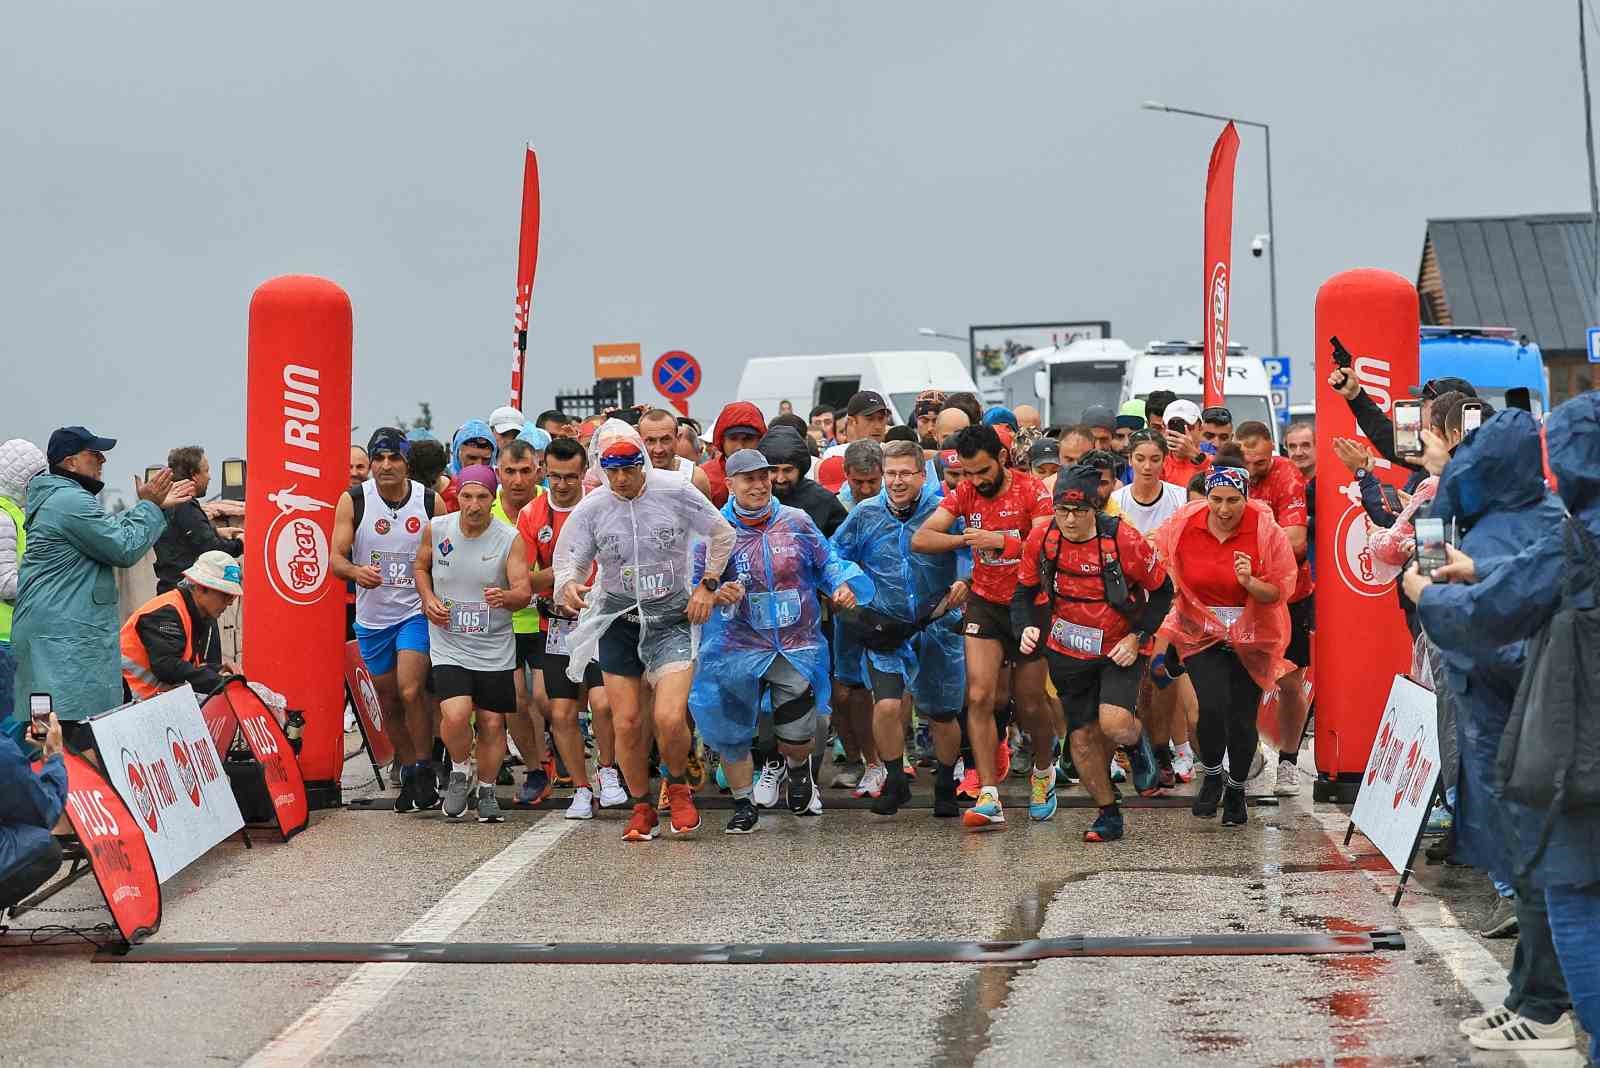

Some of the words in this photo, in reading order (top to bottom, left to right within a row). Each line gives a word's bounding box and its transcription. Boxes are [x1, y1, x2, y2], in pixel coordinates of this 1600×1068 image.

[1153, 365, 1247, 379] EKR
[389, 563, 406, 577] 92
[640, 573, 664, 590] 107
[457, 611, 480, 626] 105
[1069, 634, 1092, 651] 106
[67, 789, 120, 841] PLUS
